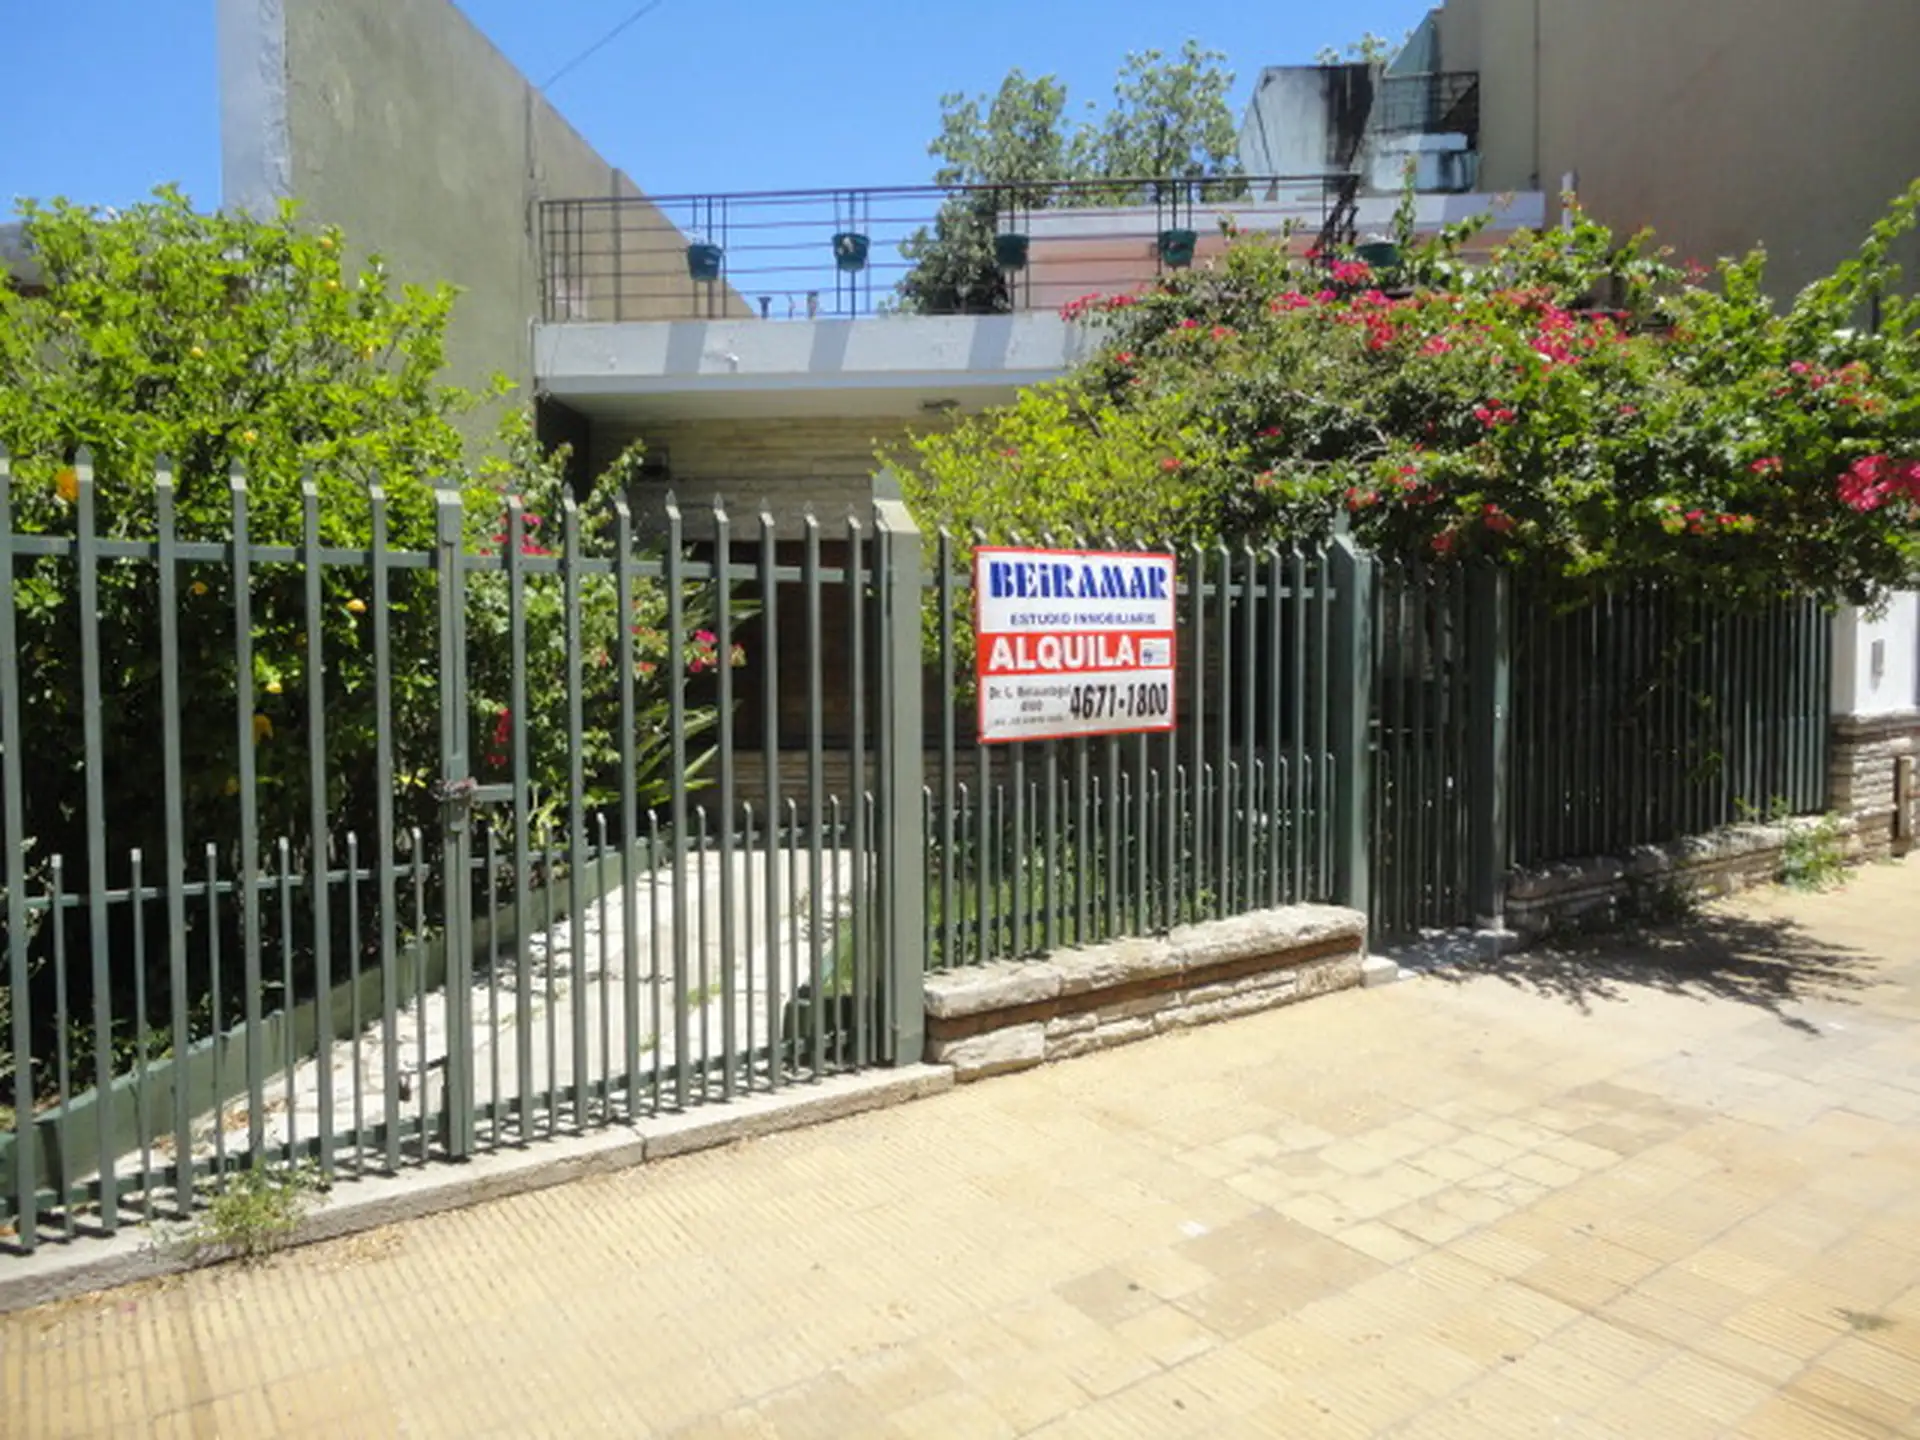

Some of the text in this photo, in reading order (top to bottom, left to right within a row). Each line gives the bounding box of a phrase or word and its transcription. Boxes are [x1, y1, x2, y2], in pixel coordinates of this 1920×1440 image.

[1010, 612, 1071, 625] ESTUDIO
[988, 635, 1136, 670] ALQUILA
[1069, 682, 1167, 719] 4671-1800
